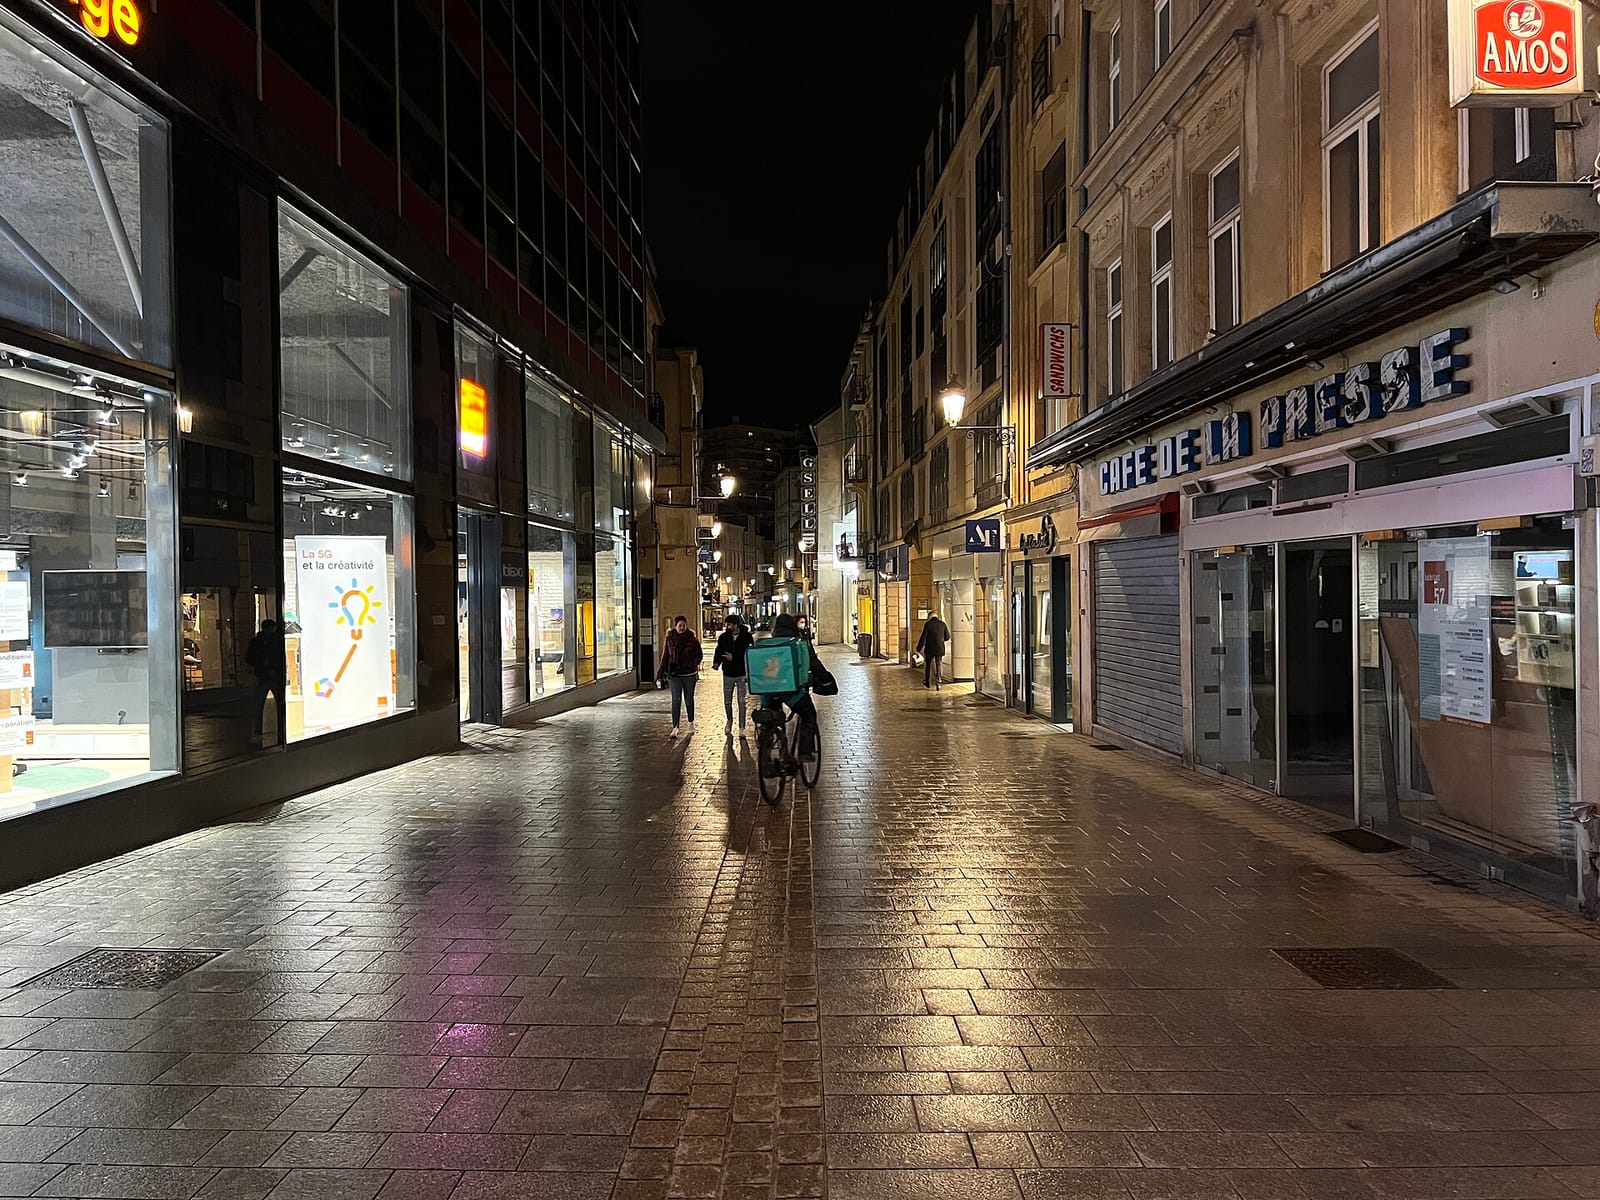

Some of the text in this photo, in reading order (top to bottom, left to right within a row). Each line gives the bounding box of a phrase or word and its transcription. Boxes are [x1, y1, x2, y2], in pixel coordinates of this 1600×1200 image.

[71, 0, 139, 45] ge
[1483, 31, 1569, 74] AMOS
[1050, 326, 1065, 393] SANDWICHS
[1099, 328, 1466, 495] CAFE DE LA PRESSE
[802, 457, 814, 529] GSELL
[302, 549, 333, 558] La 5G
[302, 560, 374, 570] et la créativité
[1434, 587, 1446, 606] 57
